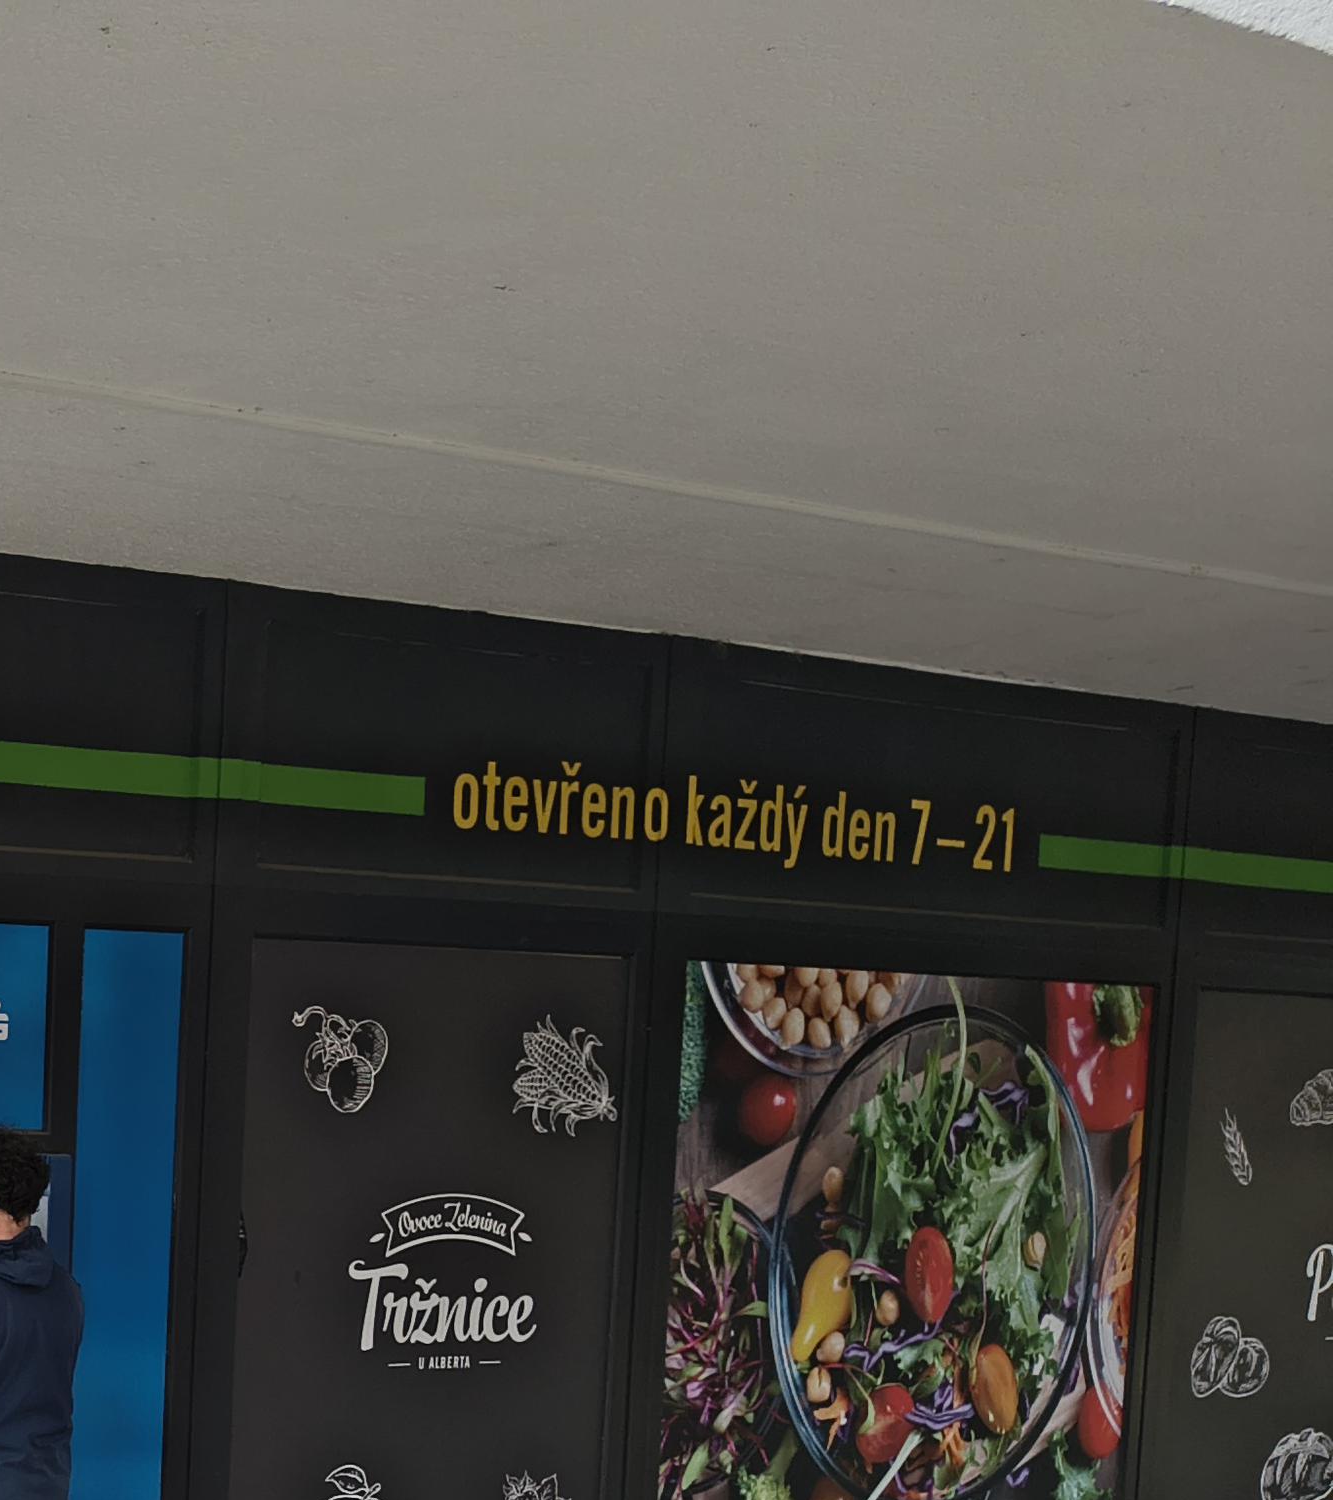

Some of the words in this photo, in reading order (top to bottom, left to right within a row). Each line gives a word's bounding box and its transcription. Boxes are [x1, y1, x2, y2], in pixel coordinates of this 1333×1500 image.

[453, 761, 669, 842] otevřeno
[686, 775, 808, 869] každý
[822, 791, 896, 862] den
[398, 1211, 443, 1238] Ovoce
[444, 1202, 507, 1237] Zelenina
[348, 1260, 537, 1351] Tržnice
[418, 1357, 425, 1370] U
[429, 1355, 470, 1369] ALBERTA
